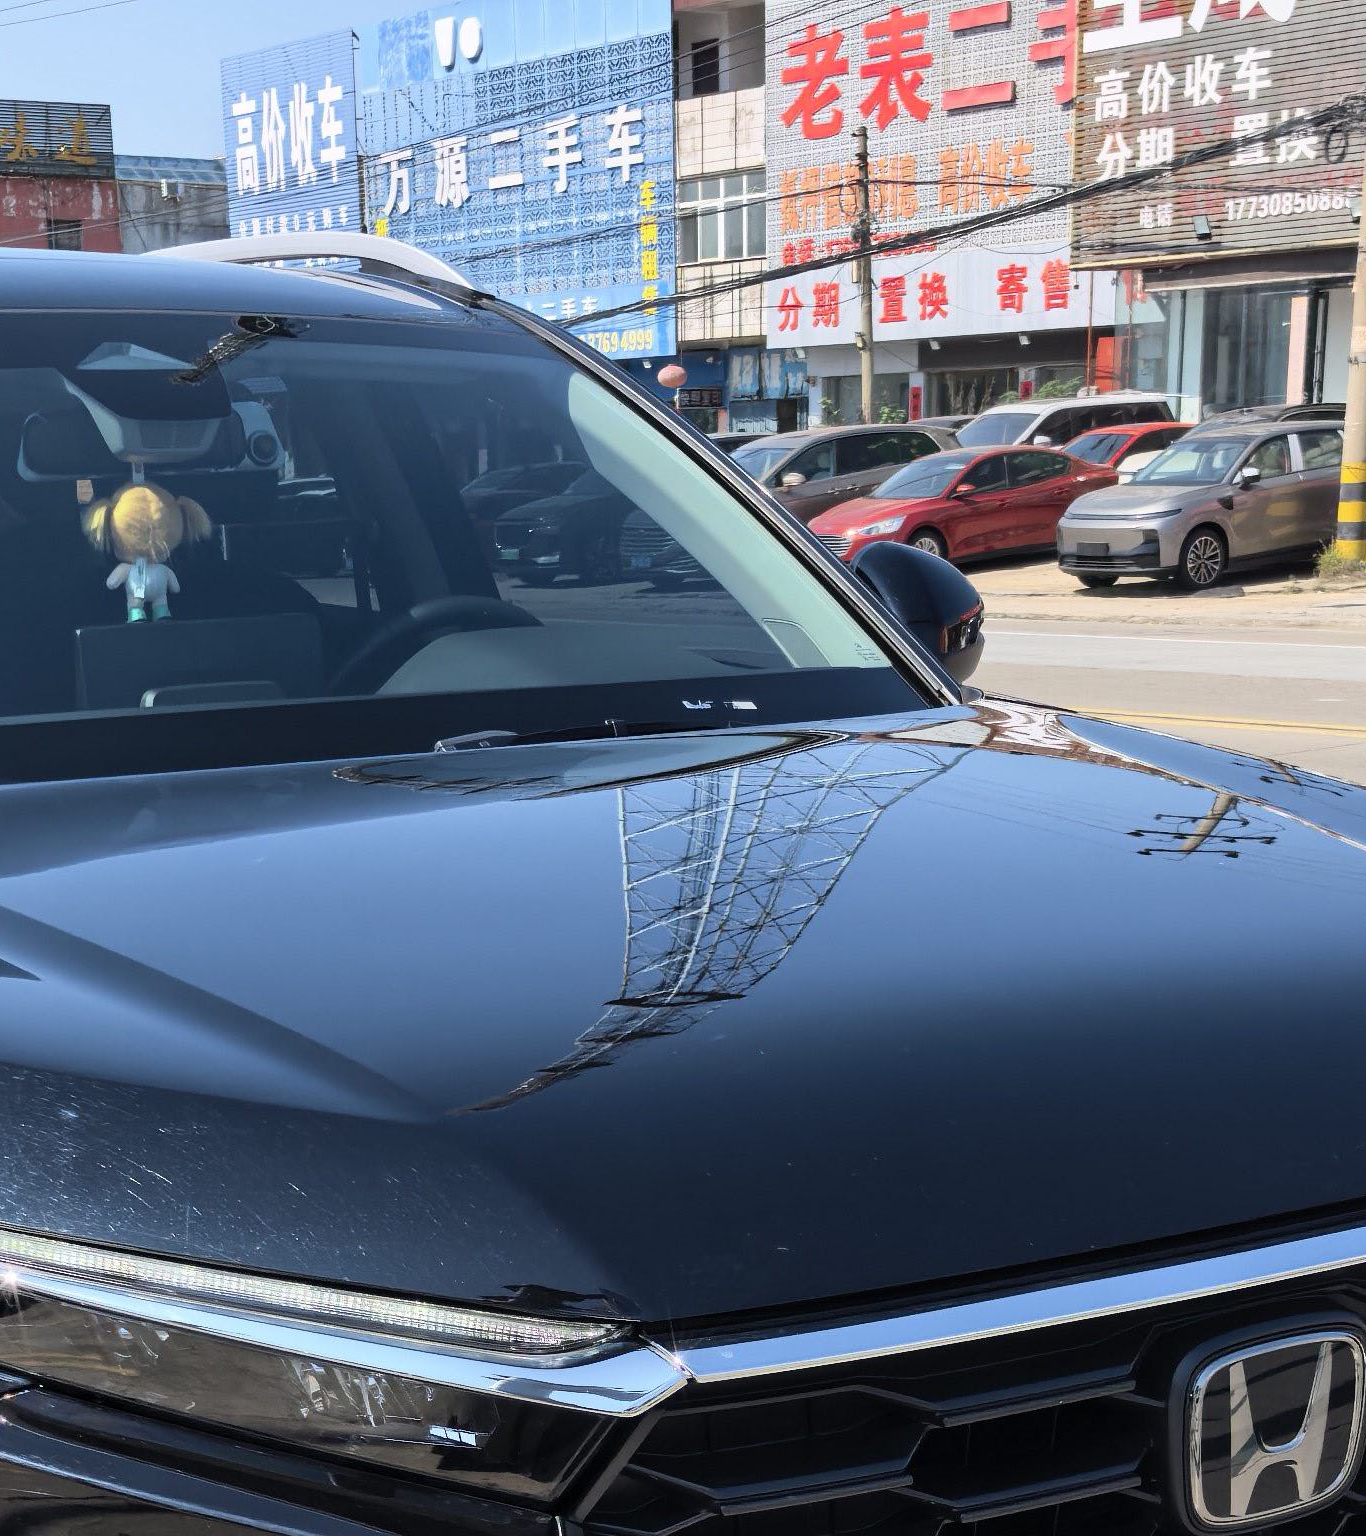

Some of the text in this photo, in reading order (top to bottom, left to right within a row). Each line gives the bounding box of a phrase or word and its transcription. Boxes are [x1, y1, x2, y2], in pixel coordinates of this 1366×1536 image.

[1094, 47, 1273, 123] 高价收车
[232, 74, 345, 196] 高价收车
[382, 105, 644, 217] 万源二手车
[1096, 107, 1319, 184] 分期 置换
[938, 137, 1035, 215] 高价收车
[1139, 203, 1173, 229] 电话
[777, 259, 1071, 332] 分期 置换 寄售
